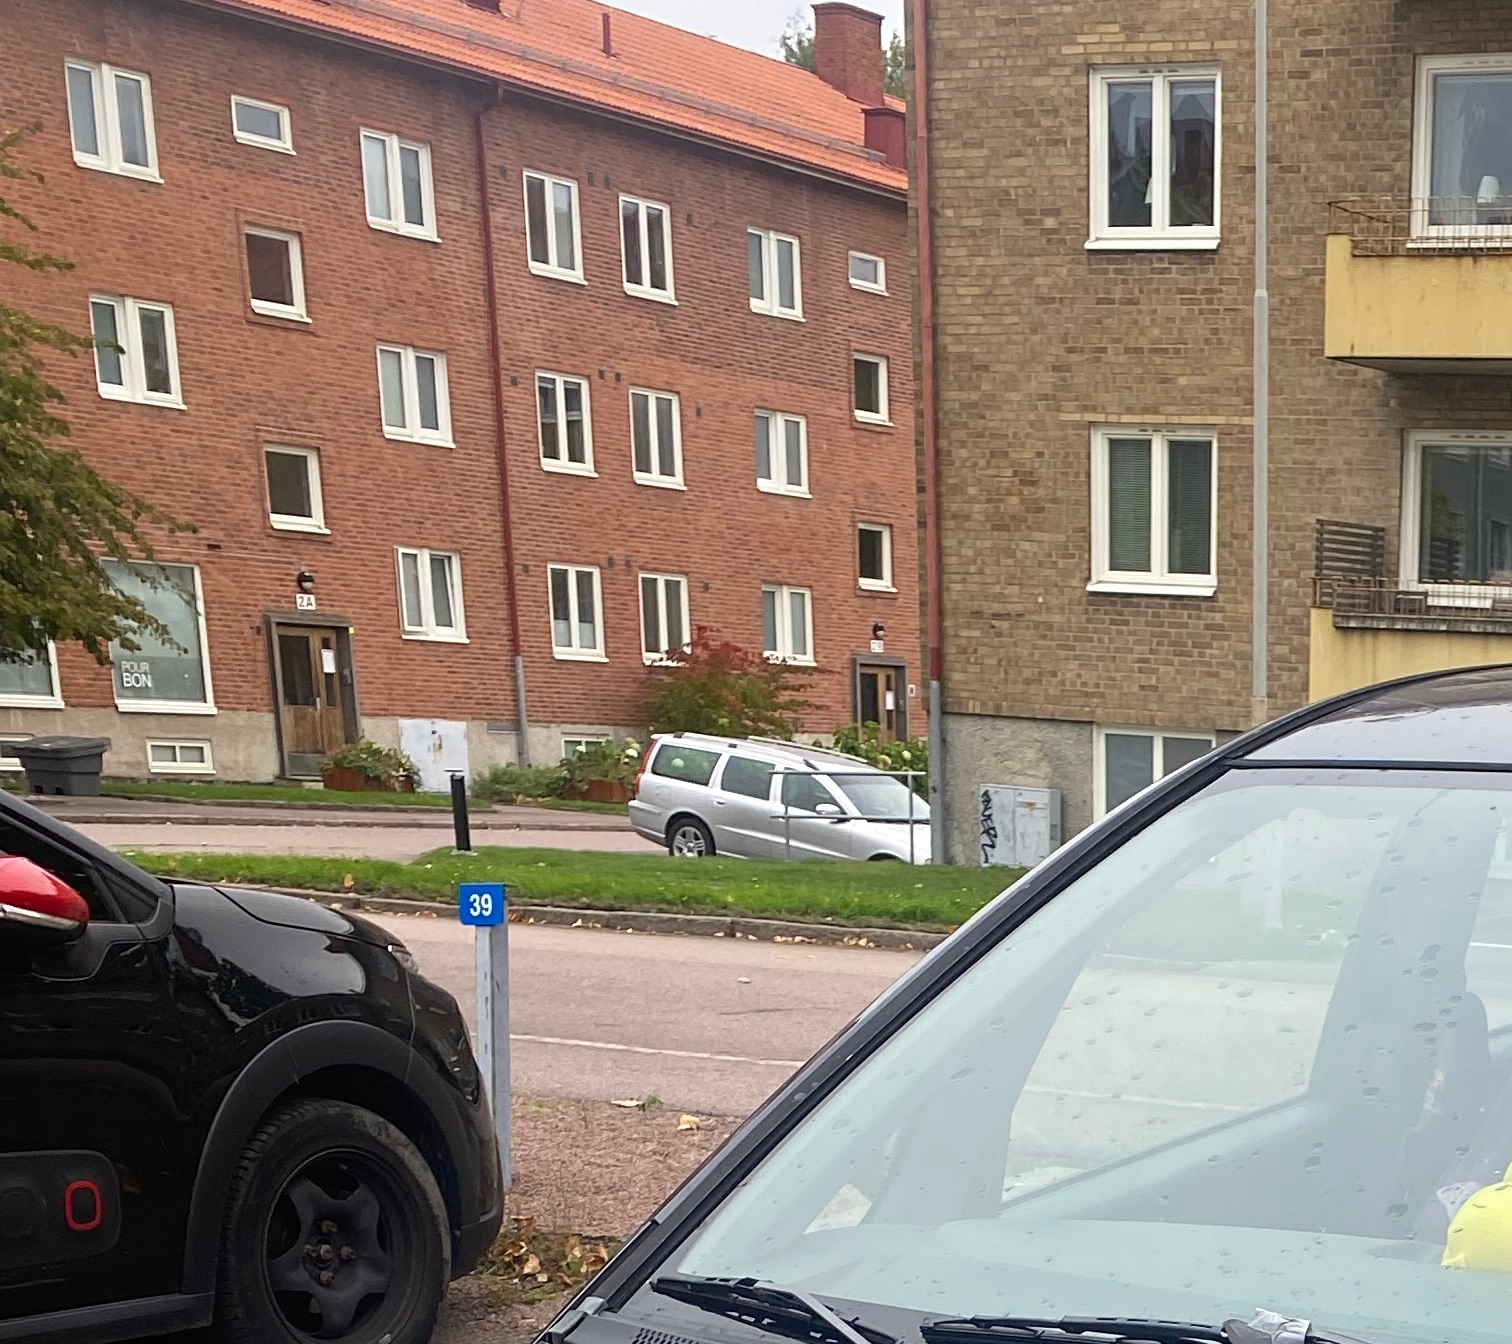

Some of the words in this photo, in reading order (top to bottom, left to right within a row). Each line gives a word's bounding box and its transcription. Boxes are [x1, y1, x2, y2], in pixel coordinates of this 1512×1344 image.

[298, 595, 313, 607] 2A
[121, 660, 150, 673] POUR
[123, 672, 152, 687] BON
[470, 893, 493, 917] 39
